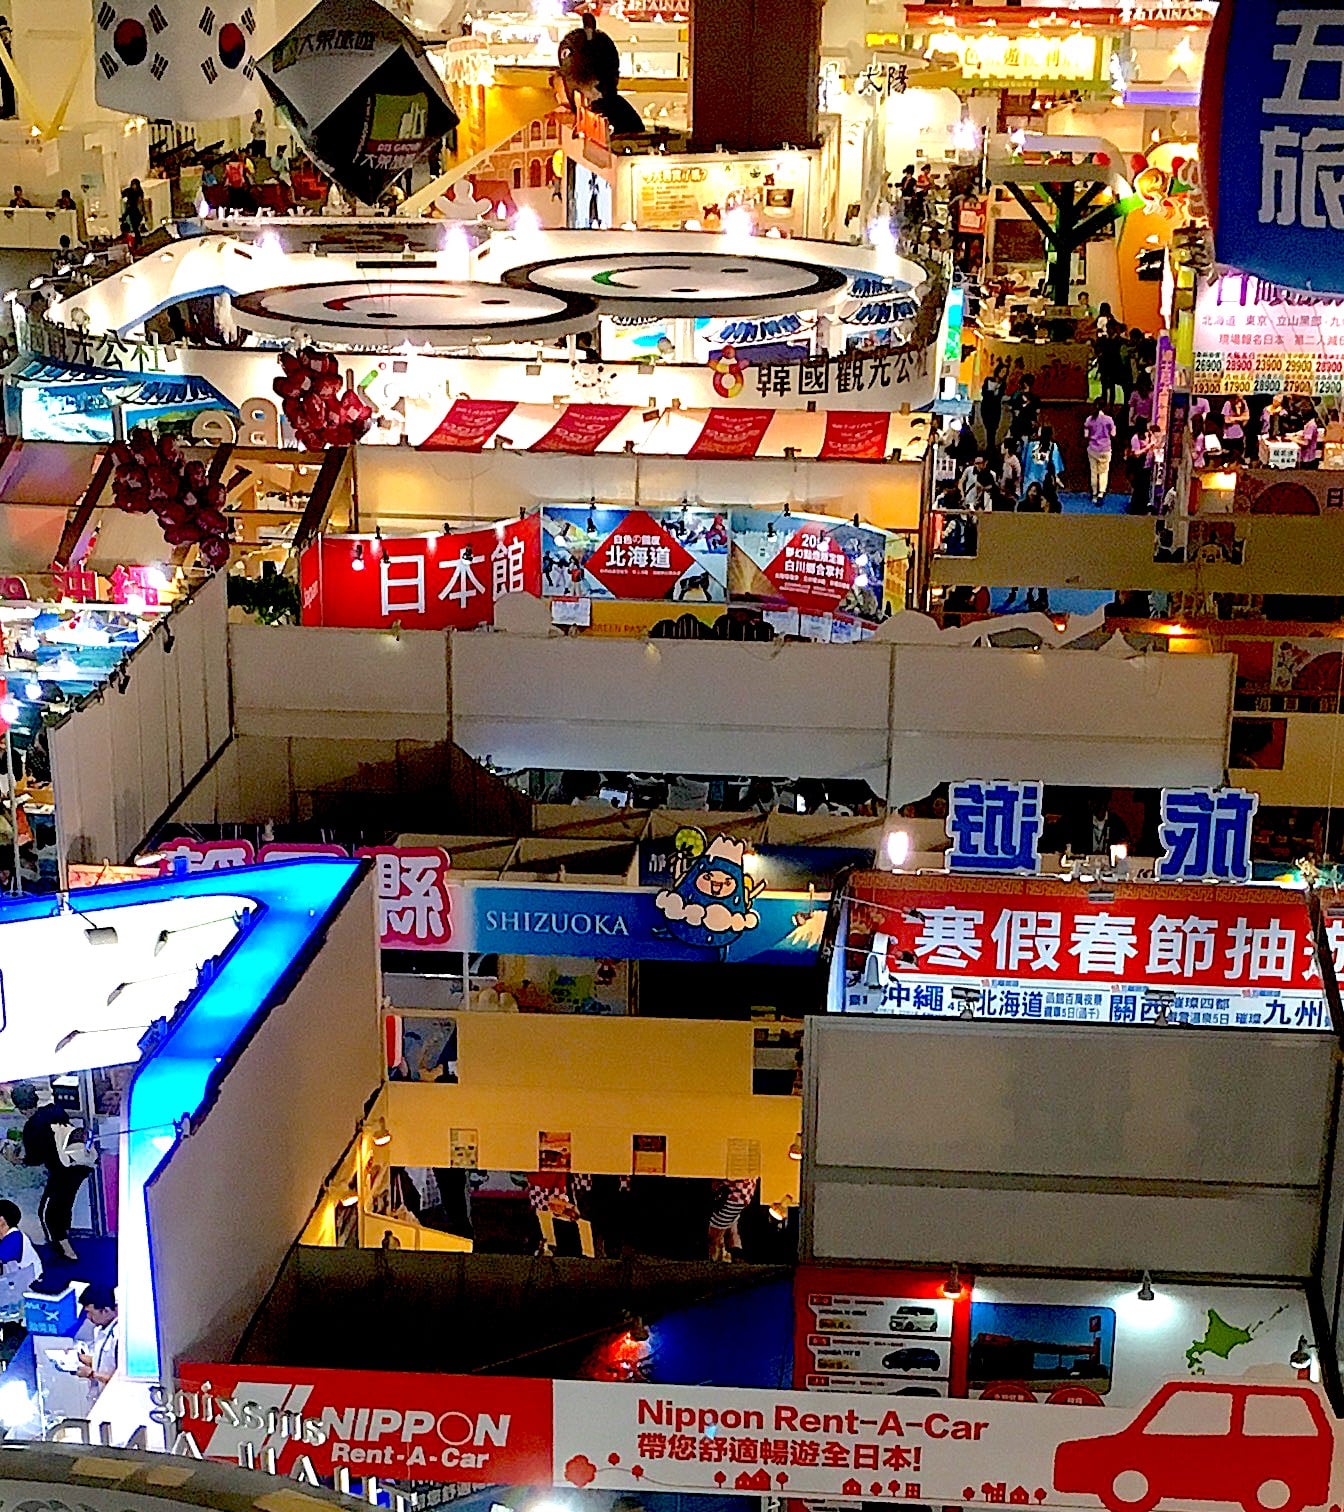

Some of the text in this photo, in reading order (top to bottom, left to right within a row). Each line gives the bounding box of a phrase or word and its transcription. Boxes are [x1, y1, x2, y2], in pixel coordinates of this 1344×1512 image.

[757, 351, 928, 398] 韓國觀光公社
[379, 539, 525, 617] 日本館
[605, 546, 671, 569] 北海道
[486, 908, 629, 937] SHIZUOKA
[1264, 999, 1324, 1029] 九州
[320, 1405, 511, 1448] NIPPON
[637, 1398, 989, 1441] Nippon Rent-A-Car
[331, 1441, 490, 1470] Rent-A-Car
[637, 1432, 922, 1473] 帶您舒適暢遊全日本!
